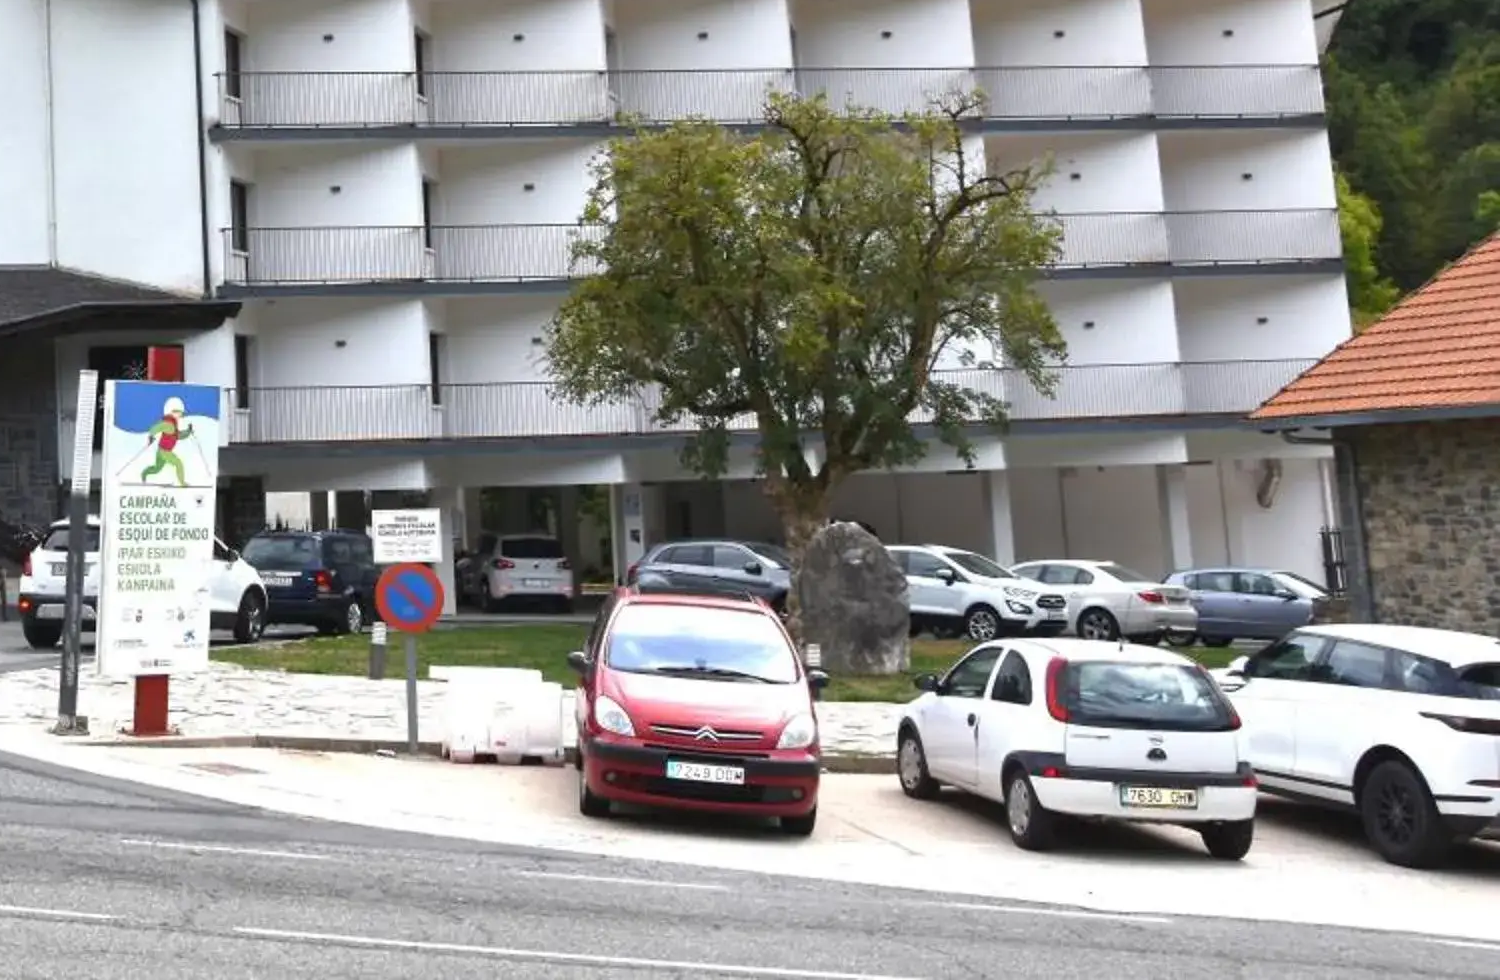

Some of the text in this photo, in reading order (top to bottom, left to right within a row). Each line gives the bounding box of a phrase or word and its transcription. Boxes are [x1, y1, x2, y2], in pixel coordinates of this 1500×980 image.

[119, 493, 177, 509] CAMPAÑA
[119, 511, 187, 525] ESCOLAR DE
[155, 527, 170, 541] DE
[171, 527, 209, 541] FONDO
[117, 578, 176, 592] KANPAINA
